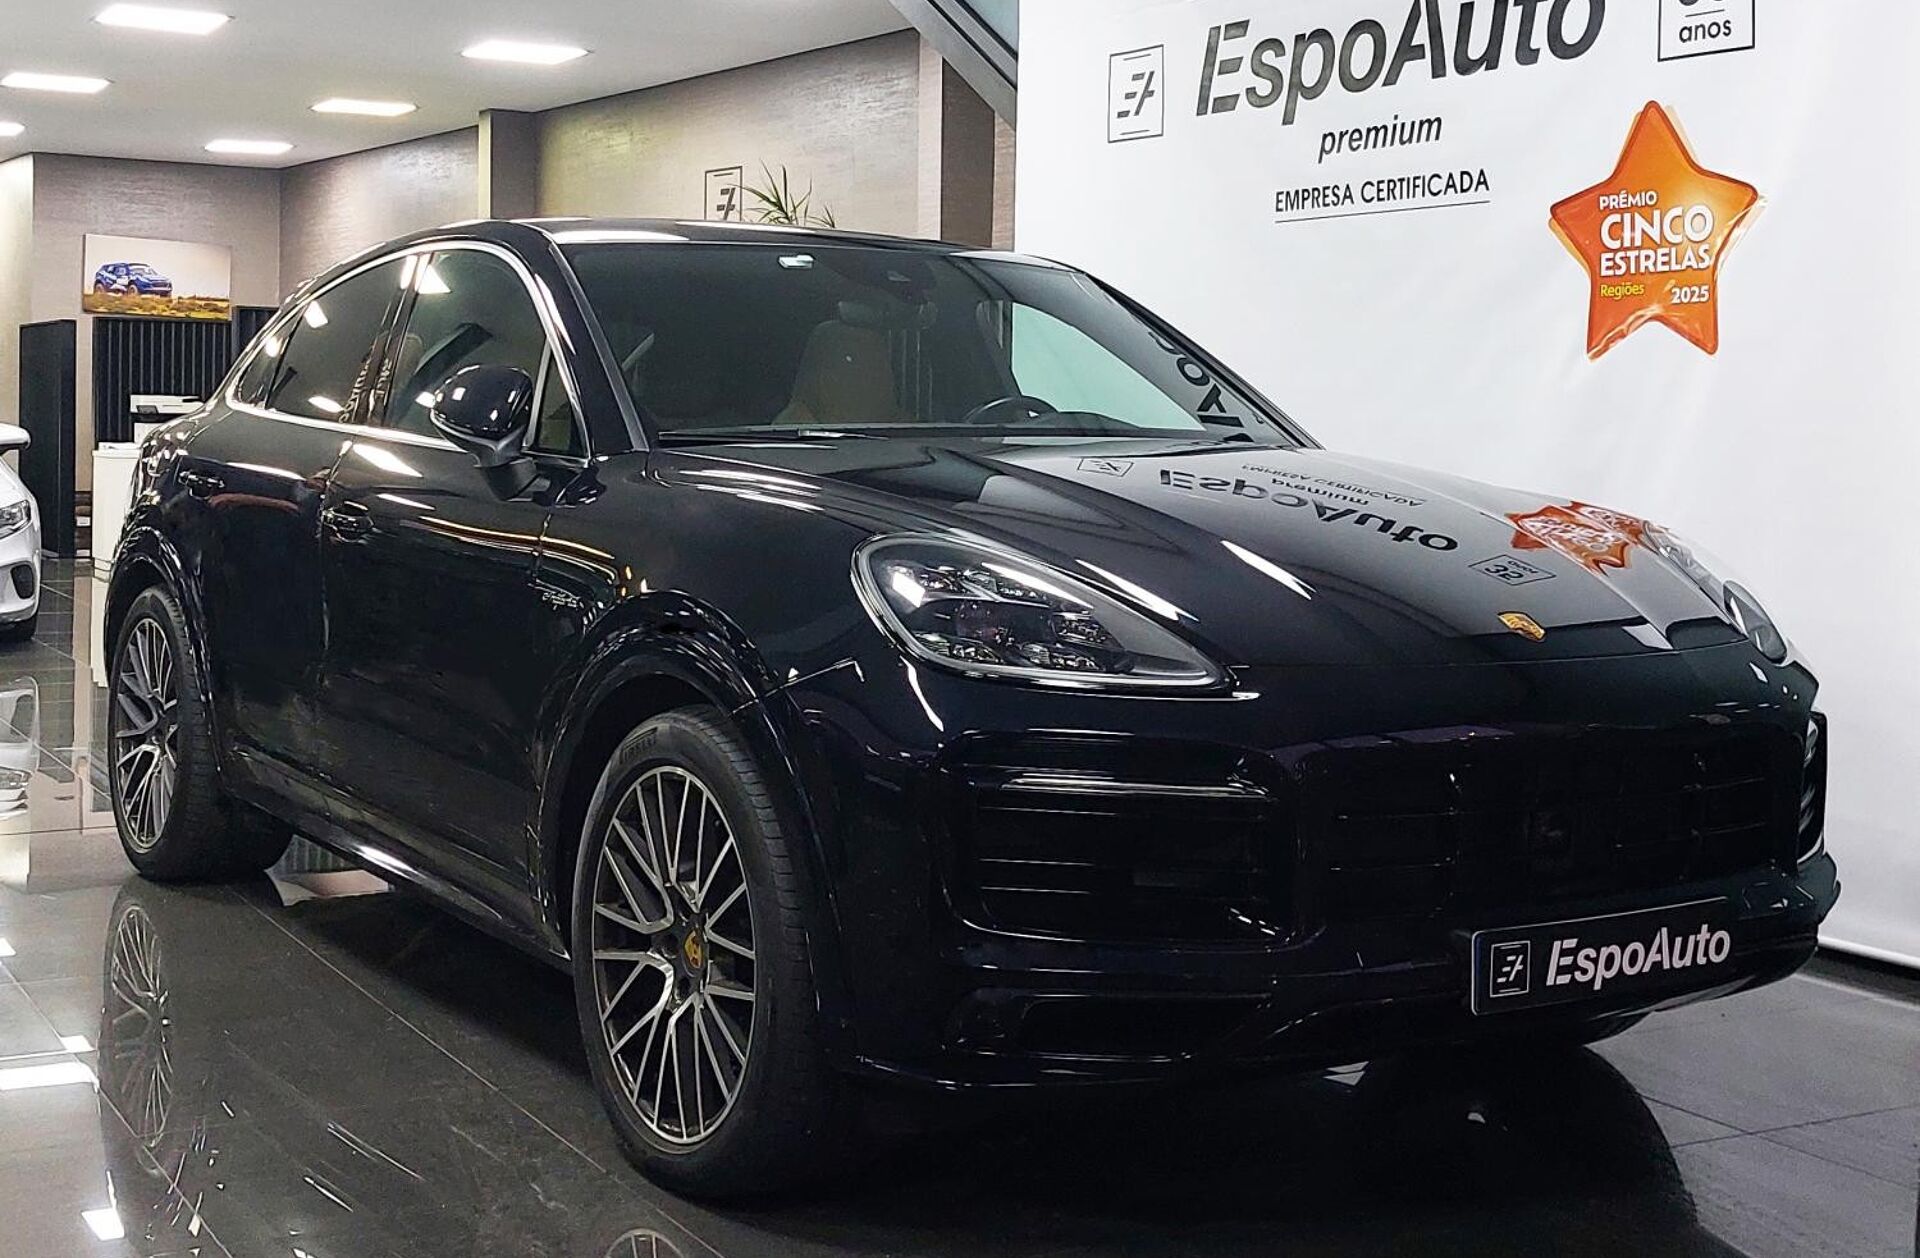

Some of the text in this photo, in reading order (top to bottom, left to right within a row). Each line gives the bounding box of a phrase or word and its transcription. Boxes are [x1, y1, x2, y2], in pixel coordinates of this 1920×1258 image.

[1679, 20, 1732, 43] anos
[1196, 0, 1606, 126] EspoAuto
[1318, 114, 1442, 164] premium
[1275, 168, 1490, 213] EMPRESA CERTIFICADA
[1600, 190, 1657, 210] PRÉMIO
[1600, 205, 1714, 250] CINCO
[1600, 244, 1711, 277] ESTRELAS
[1600, 282, 1709, 304] Regiões 2025
[1546, 924, 1730, 990] EspoAuto
